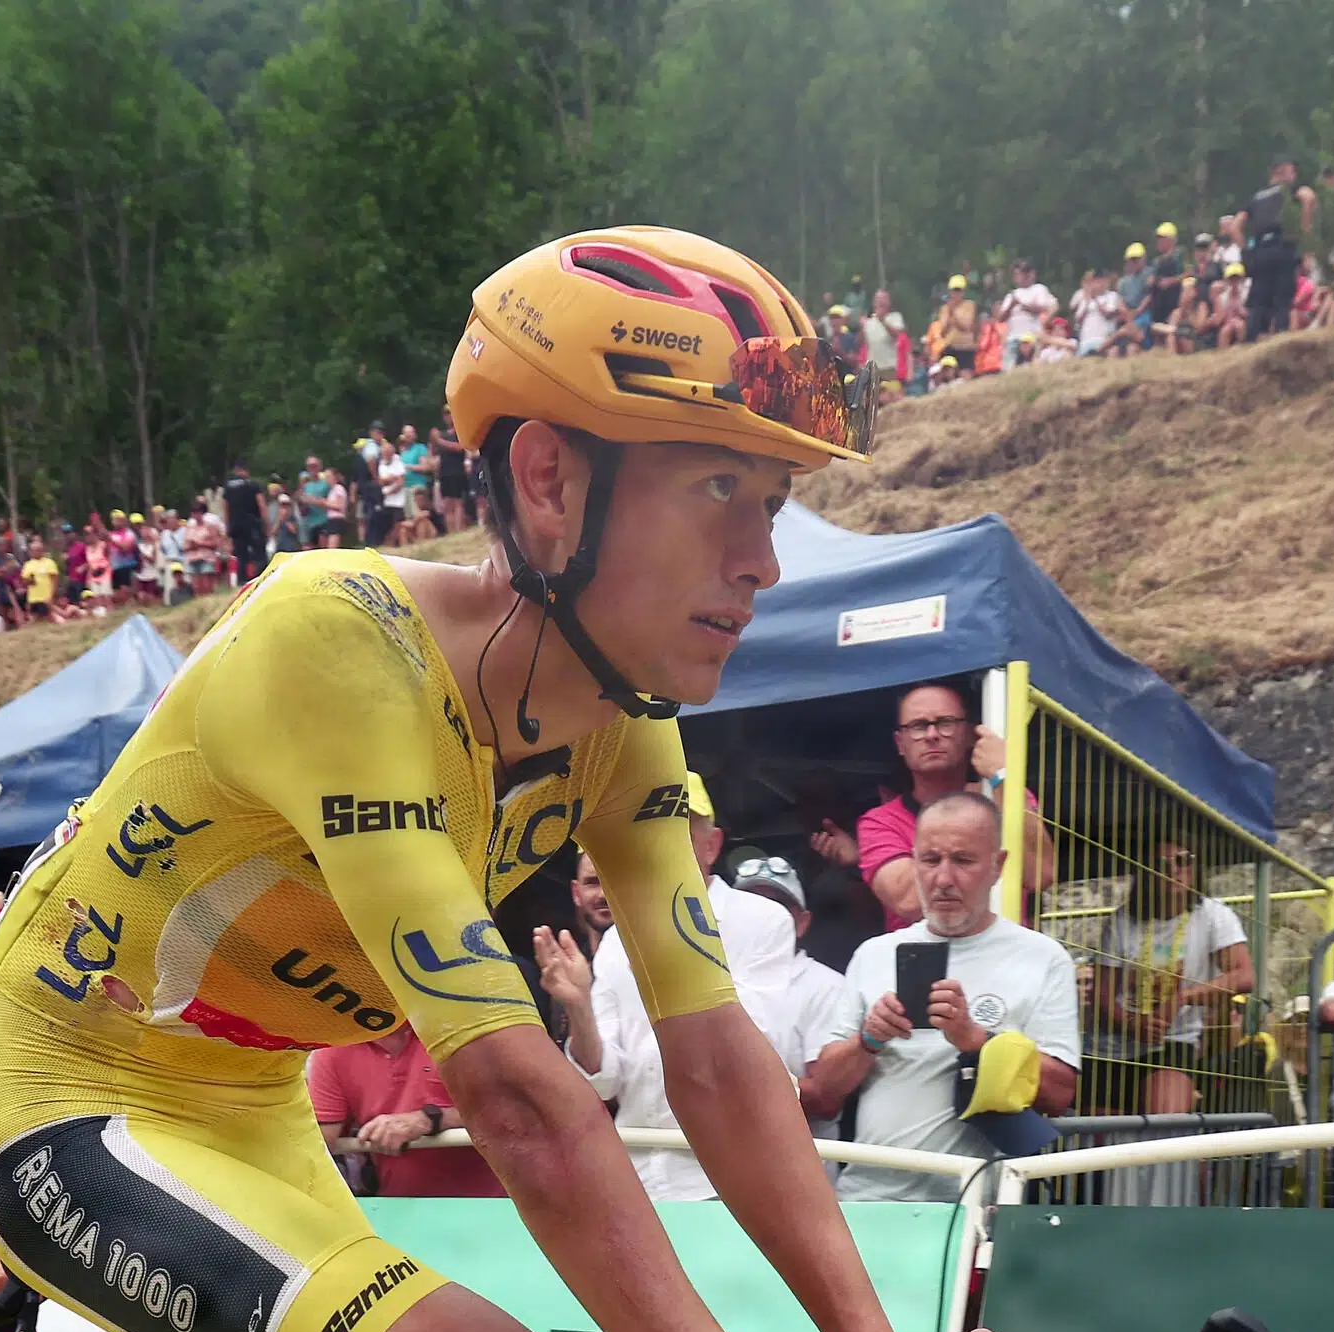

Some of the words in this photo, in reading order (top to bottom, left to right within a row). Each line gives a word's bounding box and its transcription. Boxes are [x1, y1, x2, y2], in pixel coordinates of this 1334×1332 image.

[631, 325, 703, 356] sweet
[106, 802, 214, 878] LCL
[34, 904, 124, 1004] LCL
[271, 947, 396, 1032] Uno
[11, 1143, 101, 1270] REMA
